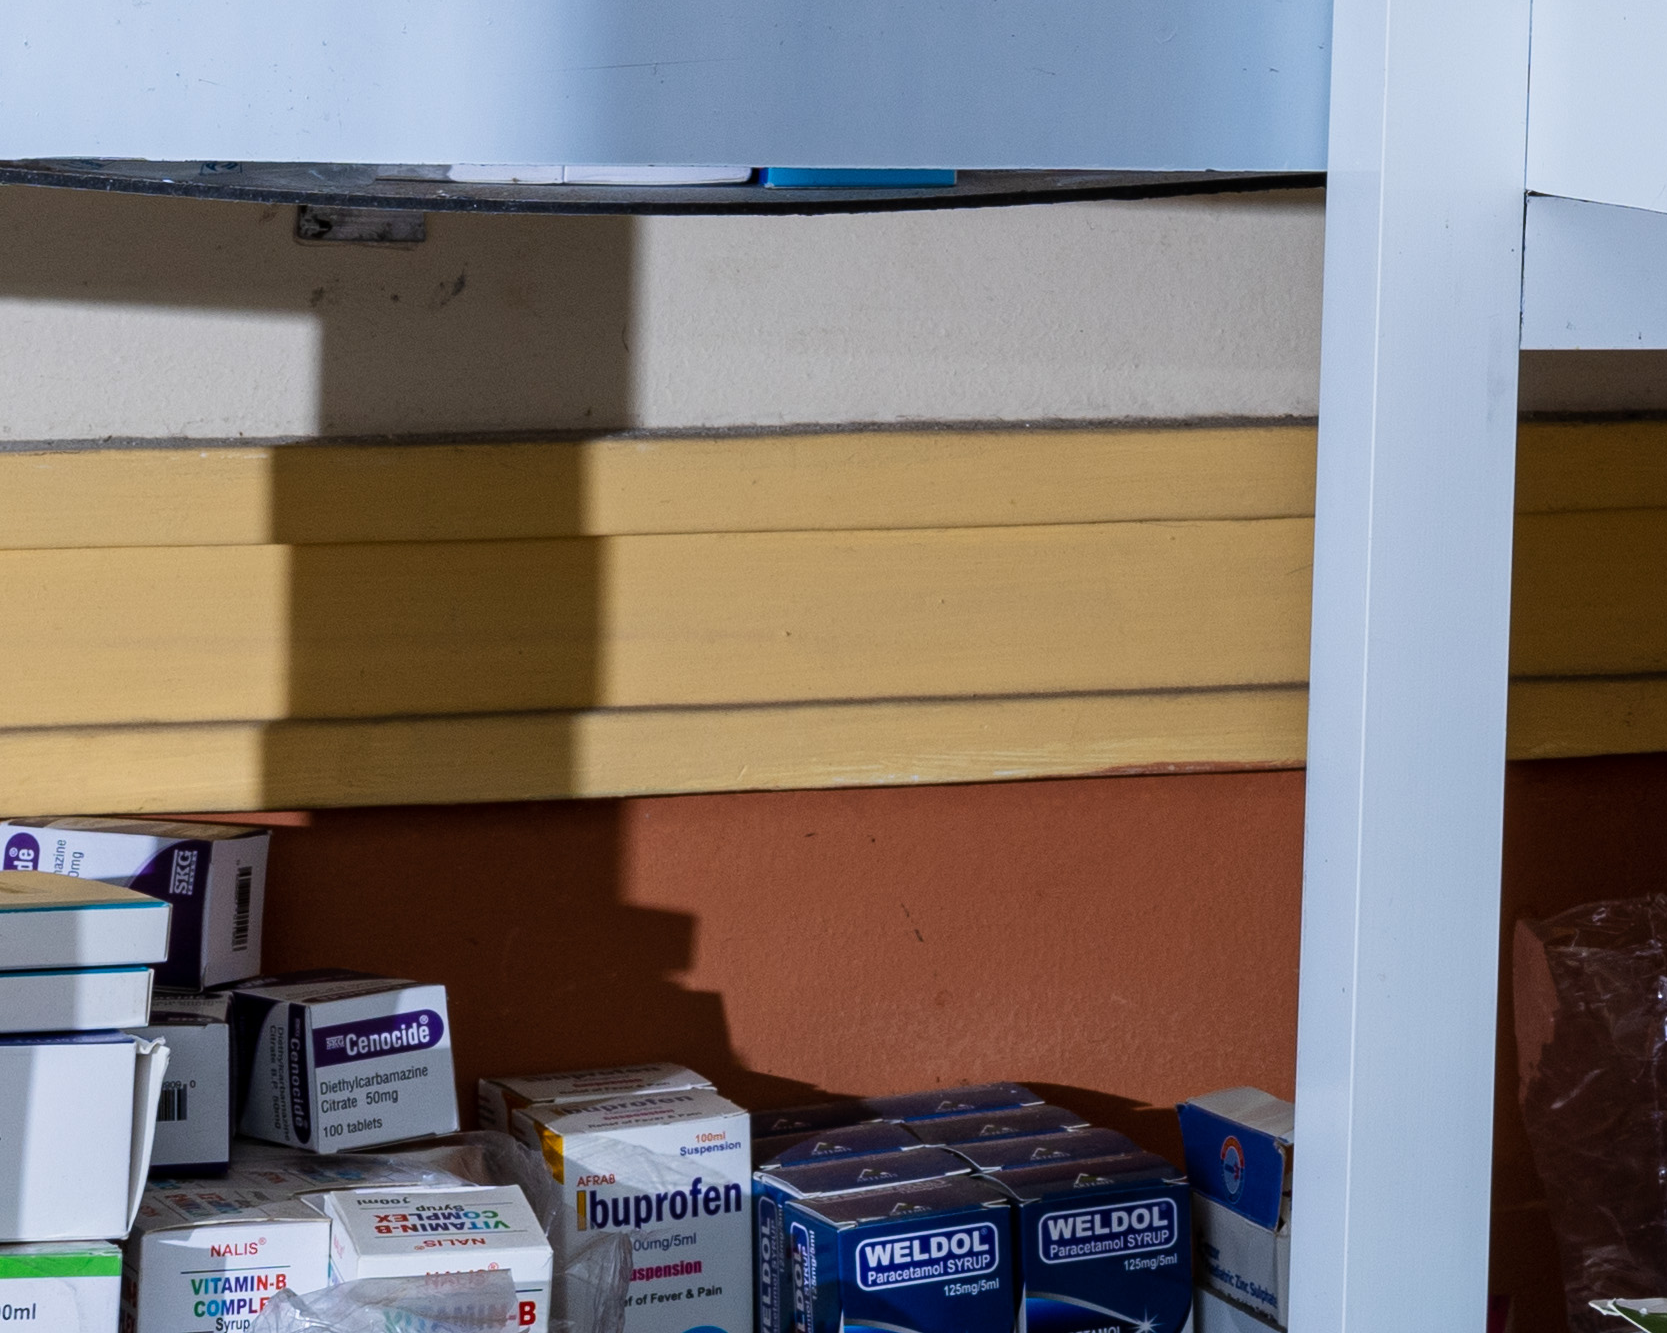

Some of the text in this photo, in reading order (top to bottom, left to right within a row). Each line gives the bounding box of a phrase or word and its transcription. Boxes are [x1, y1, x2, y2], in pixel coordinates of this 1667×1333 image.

[319, 1064, 429, 1096] Diethylcarbamazine
[321, 1089, 399, 1115] Citrate 50mg
[322, 1115, 383, 1139] 100 tablets
[576, 1173, 617, 1189] AFRAB
[576, 1178, 742, 1232] Ibuprofen
[867, 1251, 991, 1287] Paracetamol SYRUP
[191, 1274, 287, 1296] VITAMIN-B
[943, 1277, 1000, 1298] 125mg/5ml
